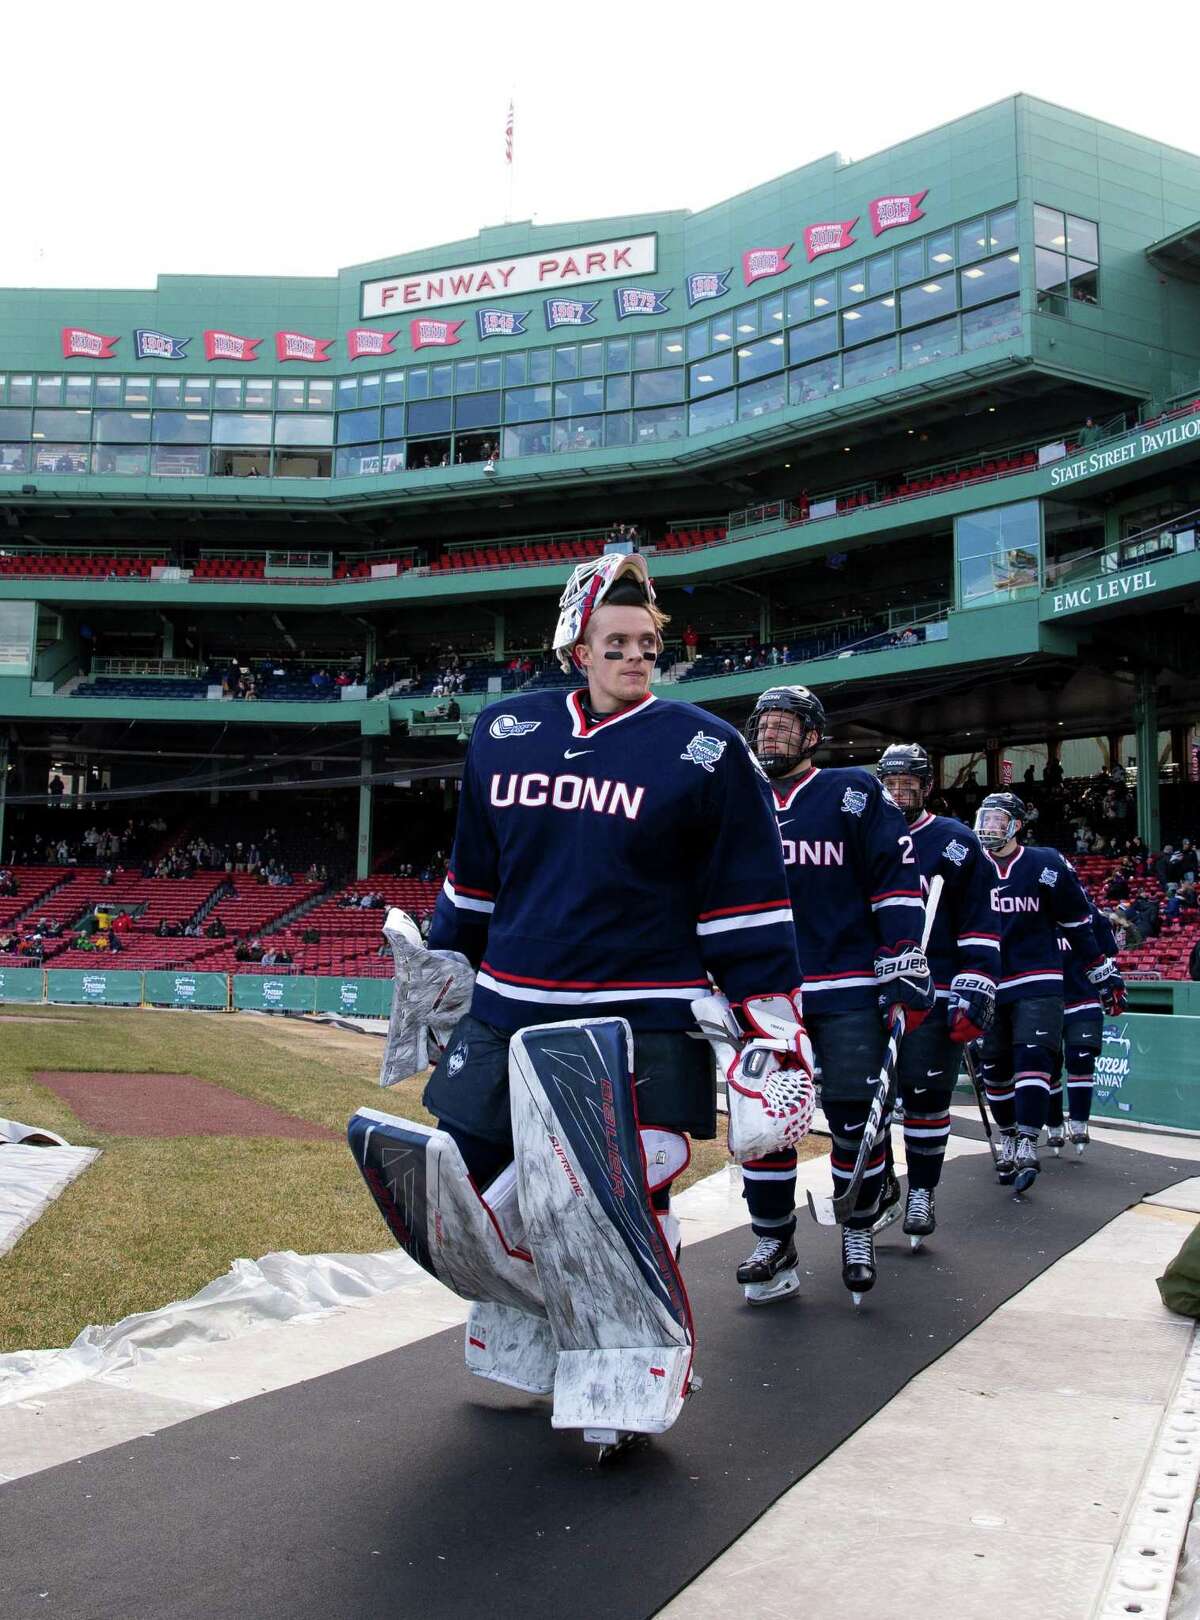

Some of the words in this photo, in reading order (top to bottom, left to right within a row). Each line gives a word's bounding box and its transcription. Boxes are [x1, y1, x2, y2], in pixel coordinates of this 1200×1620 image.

[878, 201, 912, 220] 2013
[810, 228, 843, 249] 2007
[381, 266, 516, 308] FENWAY
[539, 247, 632, 281] PARK
[552, 303, 584, 320] 1967
[622, 291, 656, 309] 1975
[1051, 460, 1089, 486] STATE
[1089, 443, 1137, 473] STREET
[1053, 587, 1092, 612] EMC
[1096, 571, 1157, 601] LEVEL
[489, 772, 646, 820] UCONN
[782, 840, 844, 866] ONN
[898, 836, 915, 864] 2
[1000, 896, 1040, 912] ONN
[955, 978, 996, 994] BAUE
